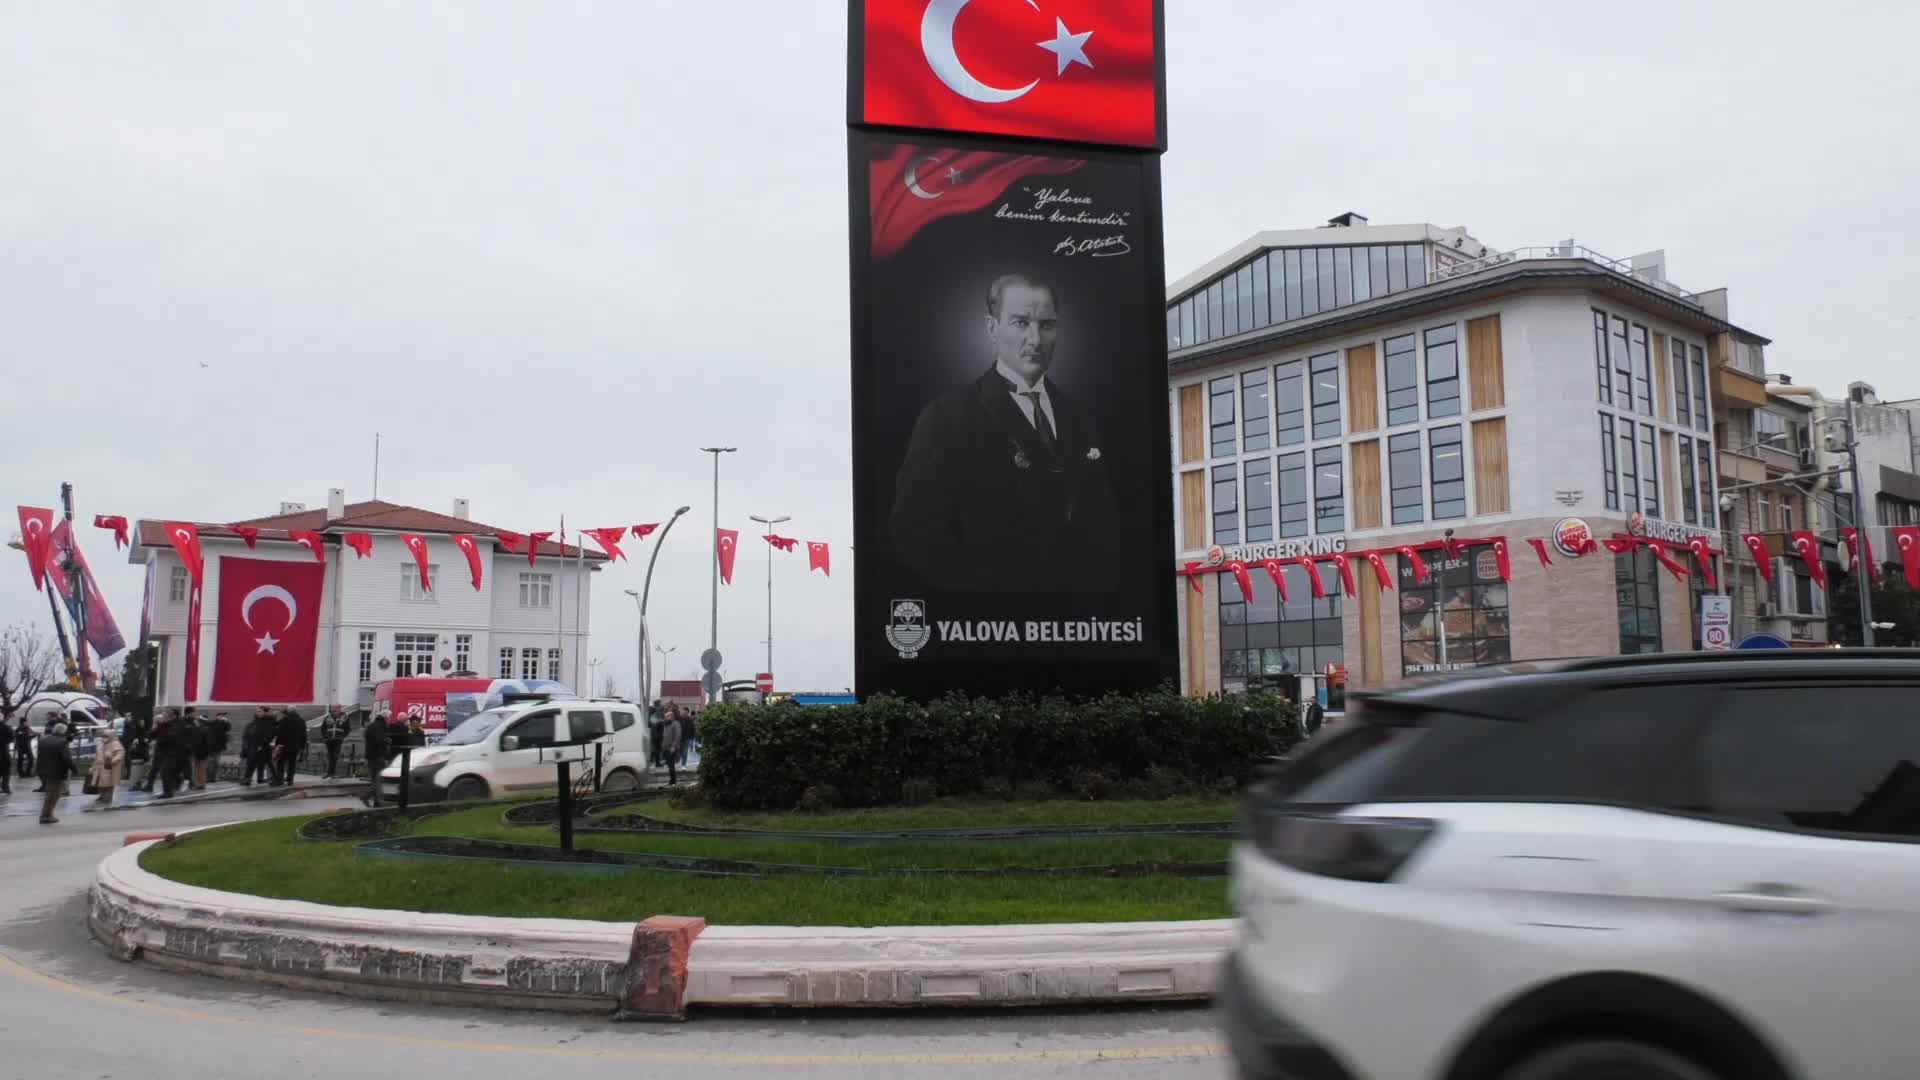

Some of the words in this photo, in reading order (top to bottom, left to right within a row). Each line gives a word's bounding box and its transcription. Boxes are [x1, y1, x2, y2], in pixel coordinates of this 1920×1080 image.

[994, 203, 1045, 221] benim
[1647, 520, 1688, 544] BURGER
[1231, 541, 1297, 563] BURGER
[1299, 535, 1346, 557] KING
[936, 621, 1020, 642] YALOVA
[1024, 616, 1143, 642] BELEDİYESİ
